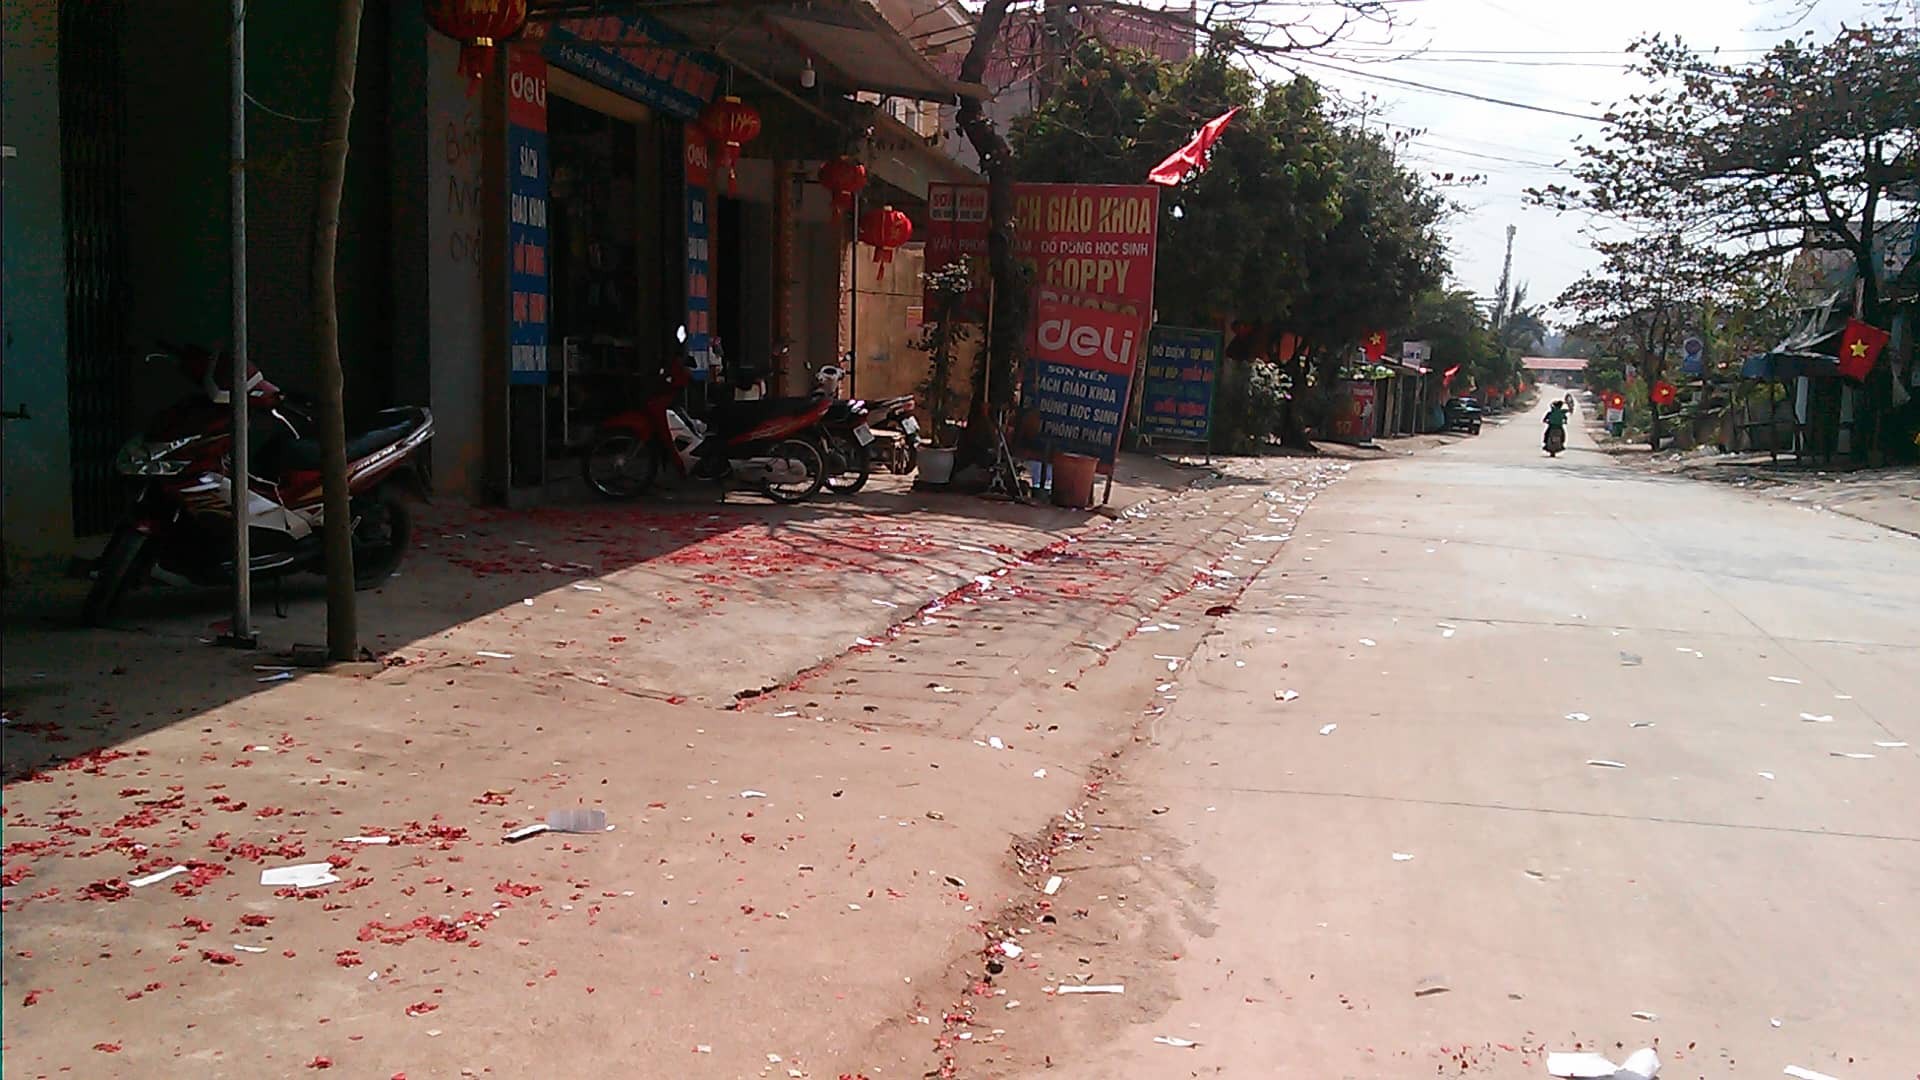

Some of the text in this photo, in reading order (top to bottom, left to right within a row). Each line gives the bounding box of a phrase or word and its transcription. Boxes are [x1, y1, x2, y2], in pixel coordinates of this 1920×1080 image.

[511, 71, 547, 105] deli
[1047, 189, 1093, 233] GIÁO
[1098, 196, 1151, 234] KHOA
[1121, 242, 1149, 257] SINH
[1046, 256, 1131, 295] COPPY
[1037, 319, 1134, 365] deli
[1088, 385, 1117, 404] KHOA
[1093, 408, 1119, 425] SINH
